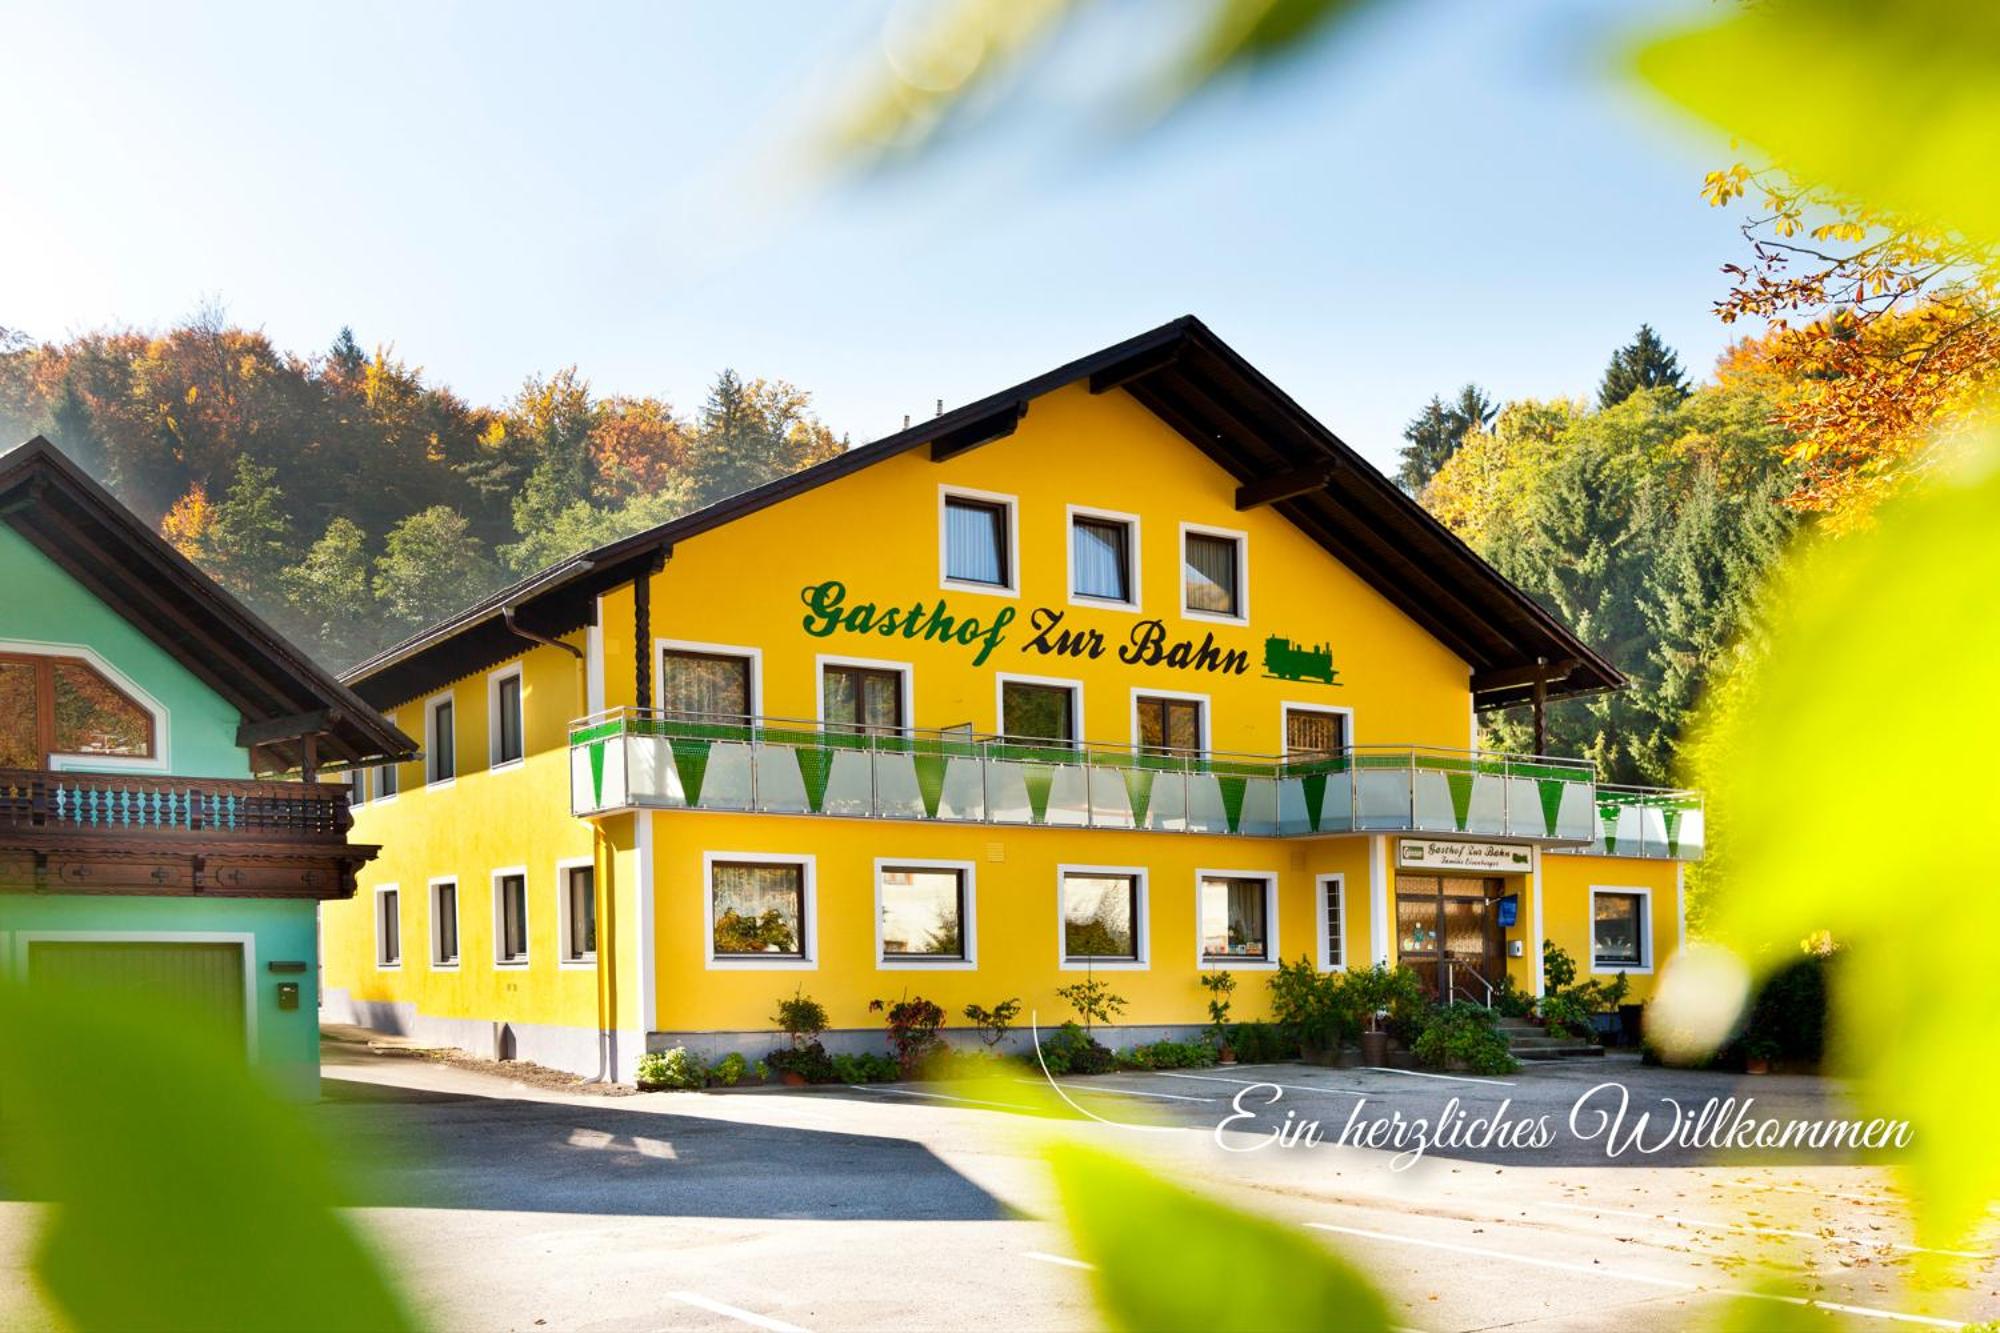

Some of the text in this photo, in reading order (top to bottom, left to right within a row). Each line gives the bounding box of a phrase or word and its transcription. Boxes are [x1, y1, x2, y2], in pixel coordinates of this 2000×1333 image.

[801, 581, 1248, 675] Gasthof Zur Bahn
[1428, 843, 1464, 857] Gasthof
[1468, 844, 1482, 856] Zur
[1485, 846, 1510, 857] Bahn
